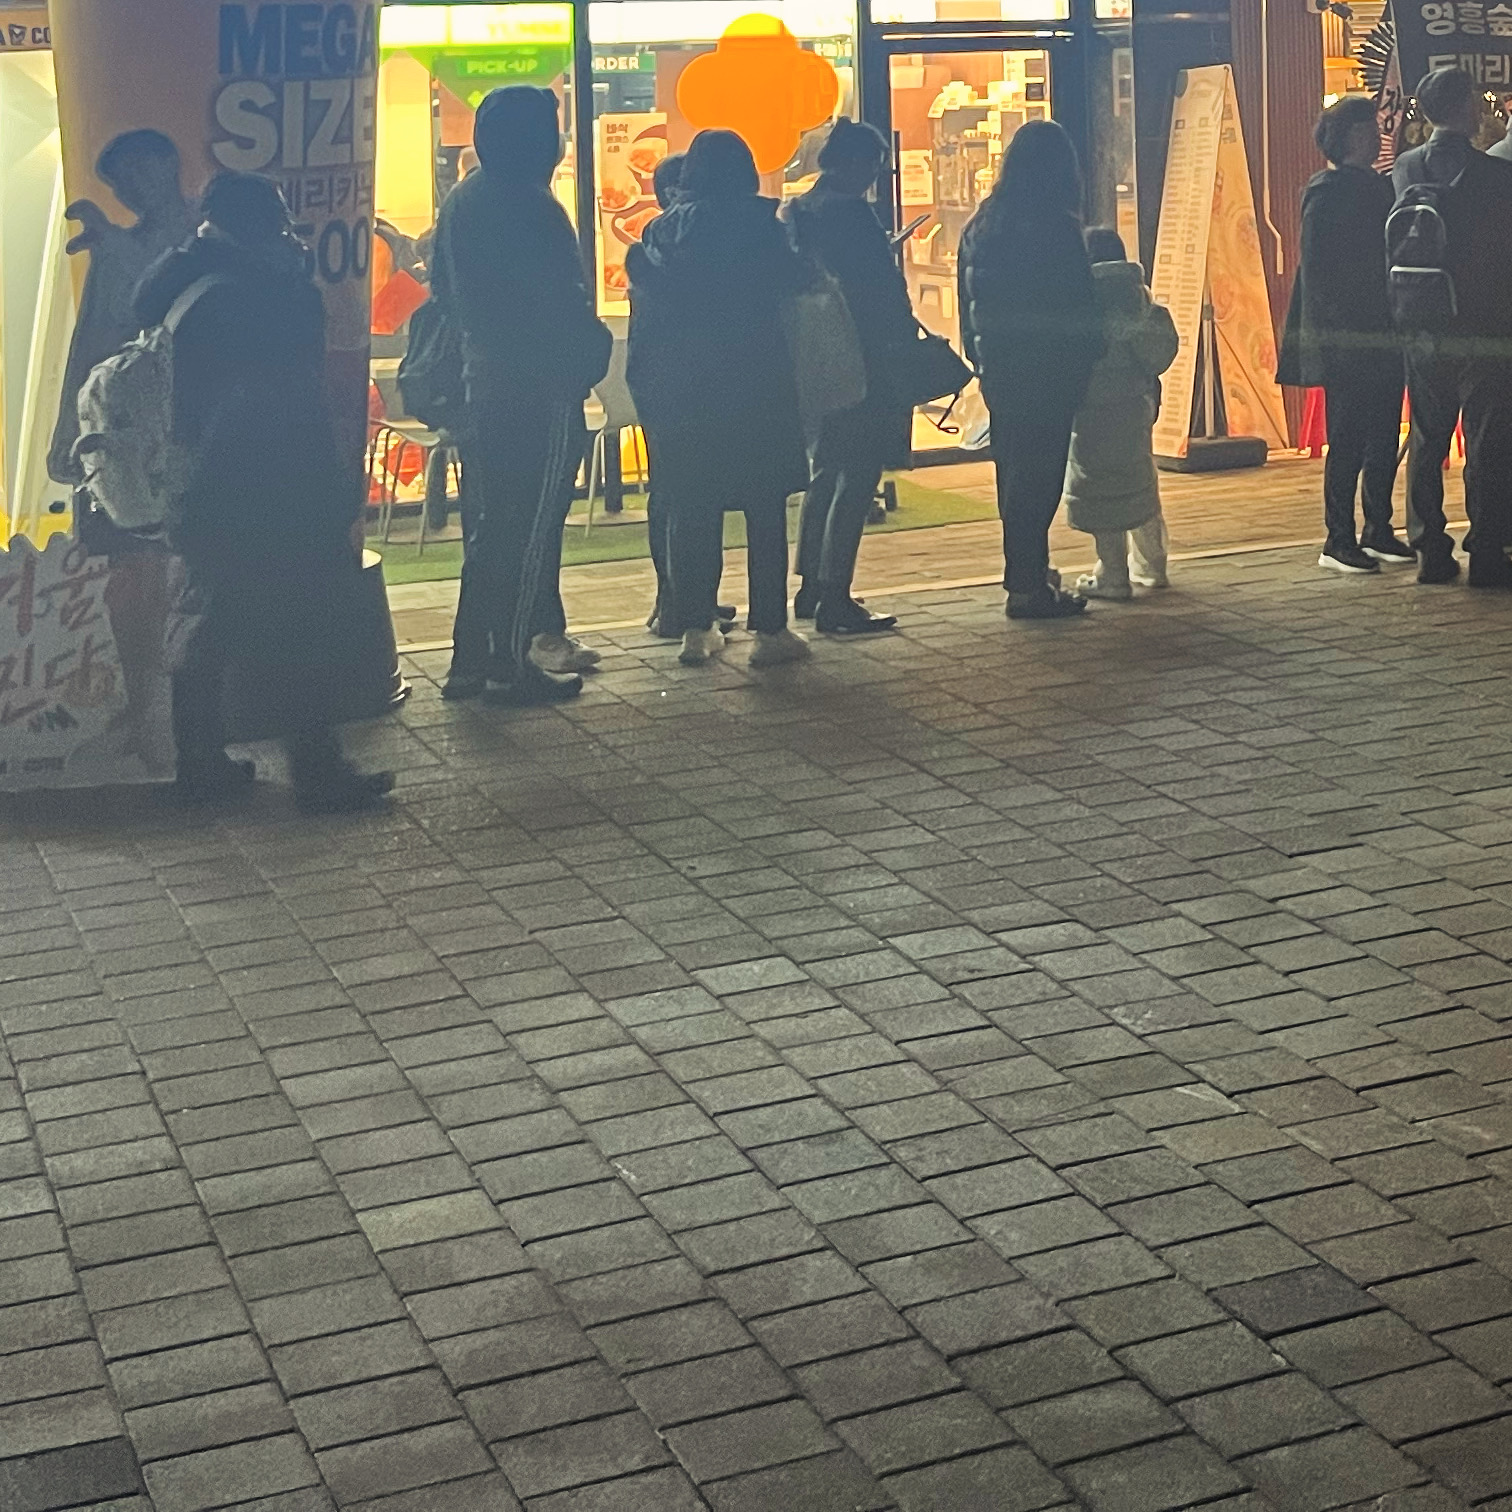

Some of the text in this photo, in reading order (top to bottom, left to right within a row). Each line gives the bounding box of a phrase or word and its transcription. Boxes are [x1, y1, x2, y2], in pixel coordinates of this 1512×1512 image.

[218, 2, 376, 76] MEGA
[466, 59, 538, 74] PICK-UP
[591, 56, 640, 71] RDER
[211, 76, 374, 172] SIZE
